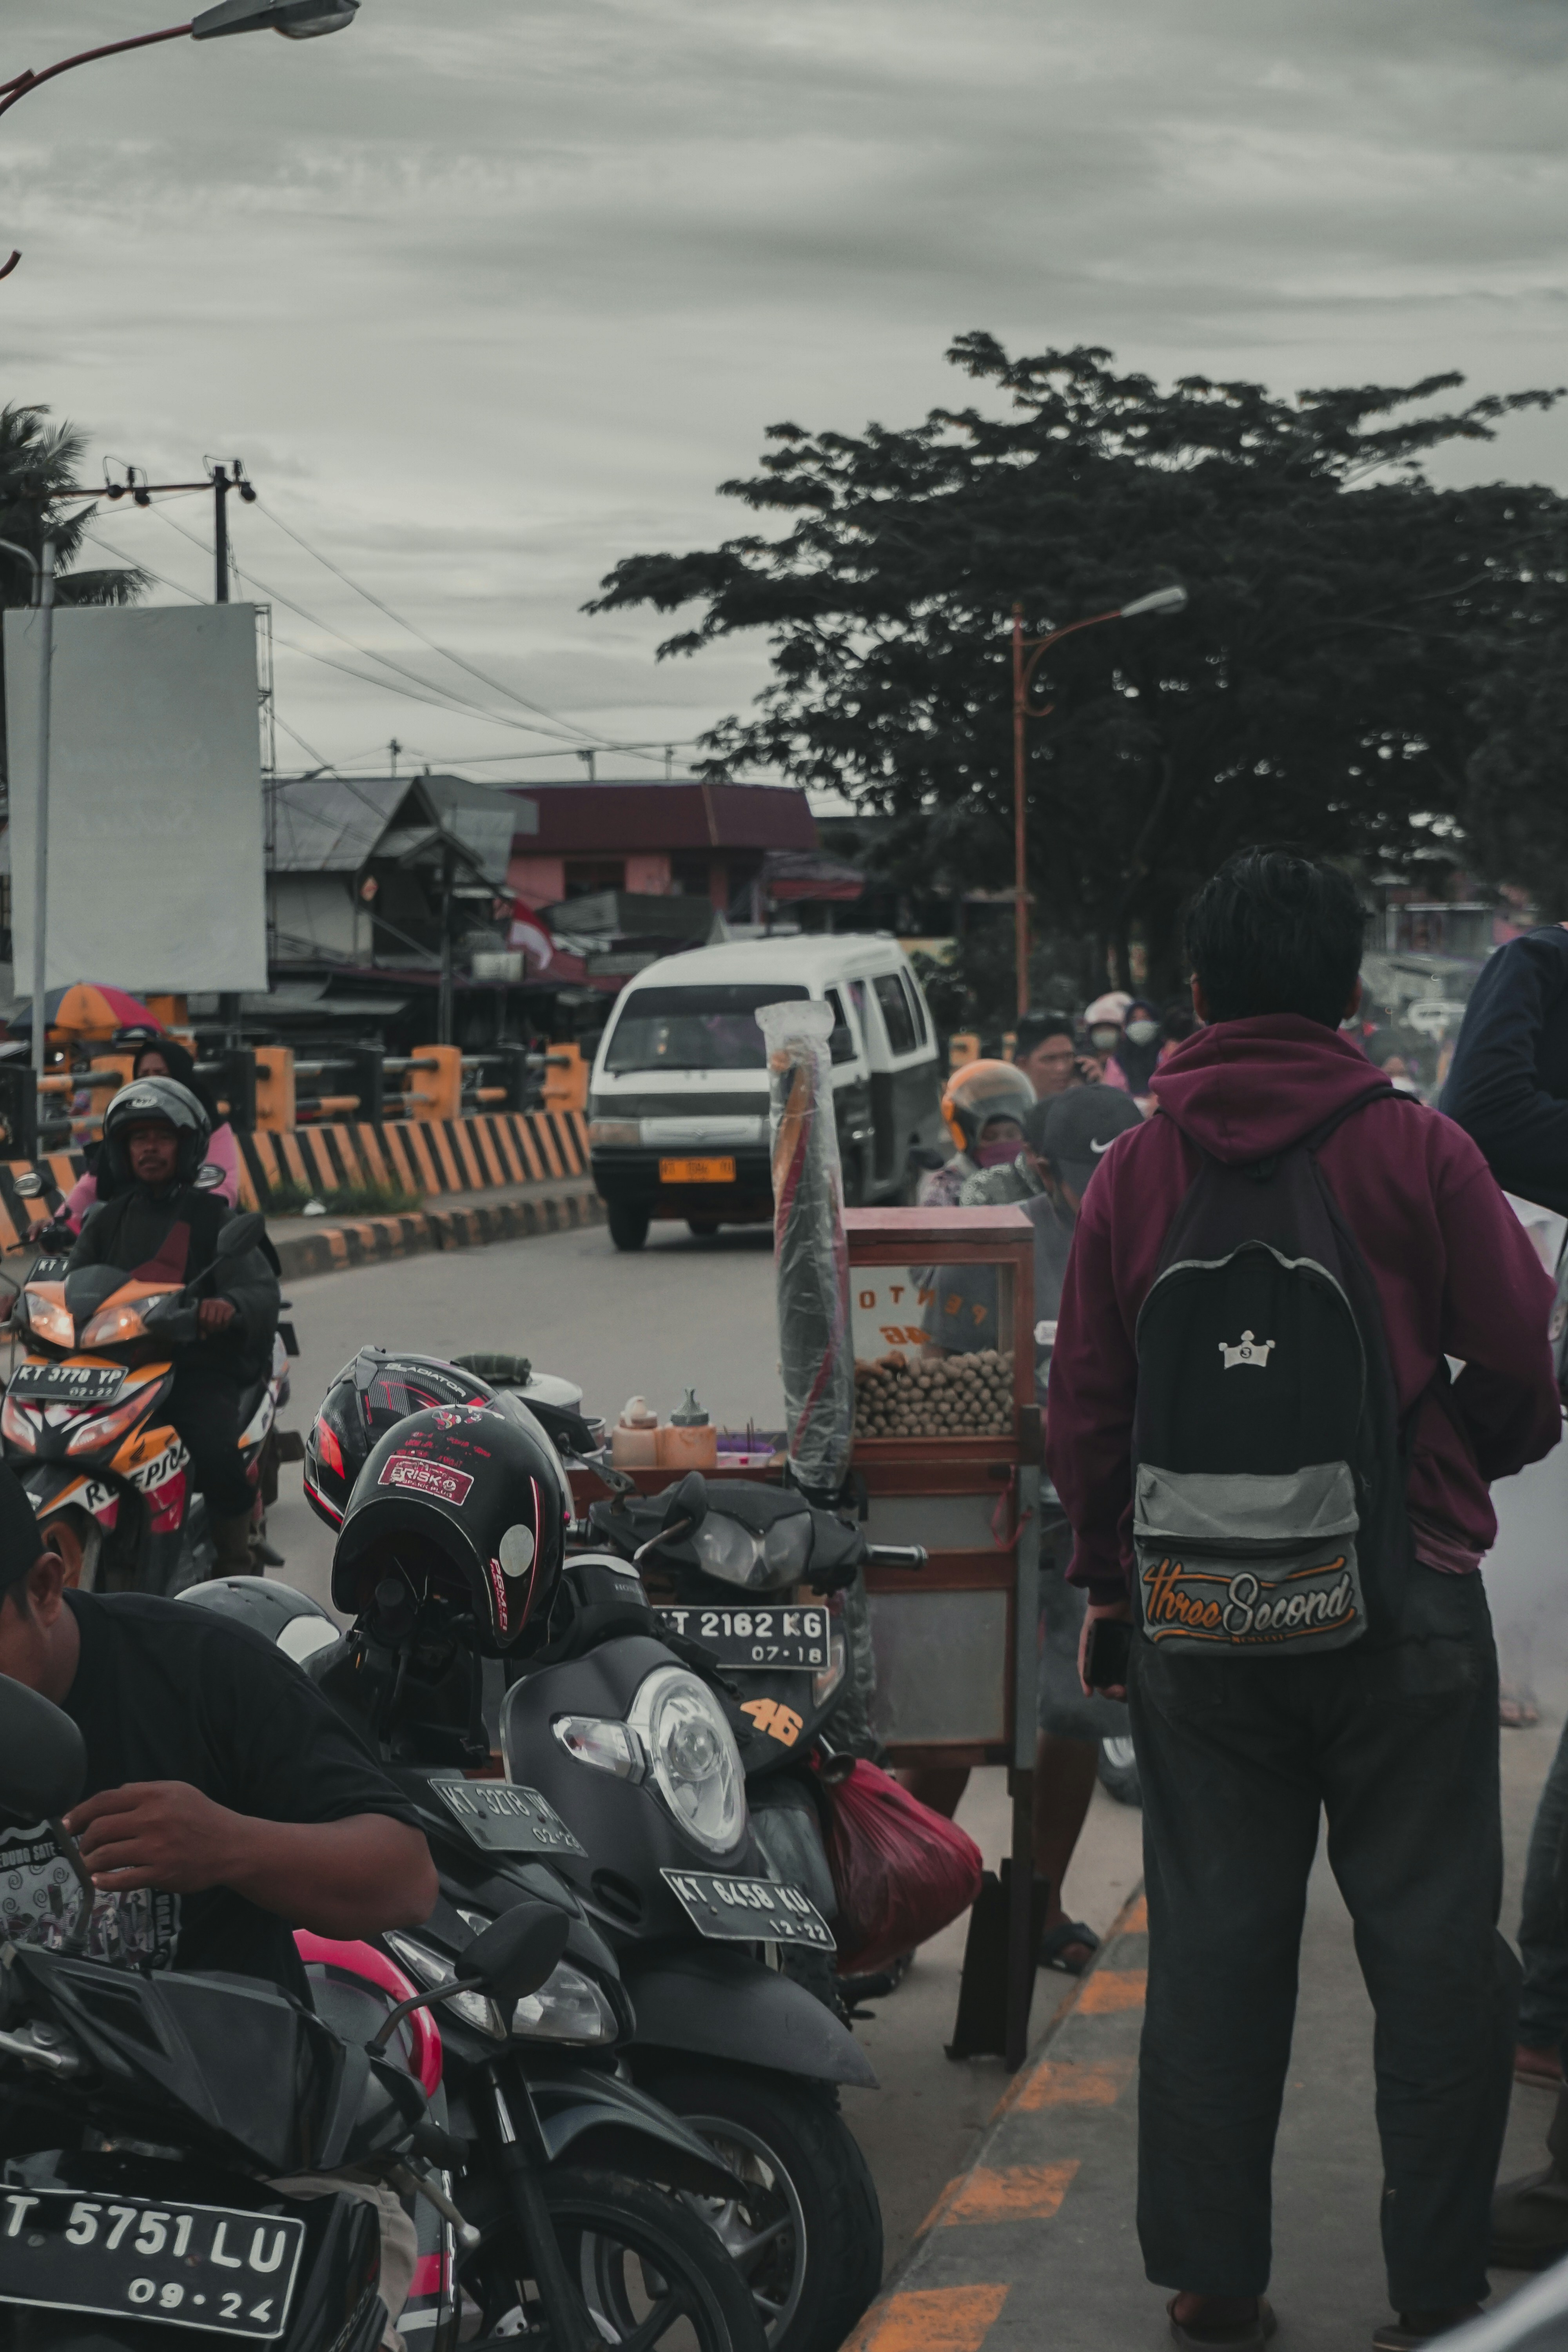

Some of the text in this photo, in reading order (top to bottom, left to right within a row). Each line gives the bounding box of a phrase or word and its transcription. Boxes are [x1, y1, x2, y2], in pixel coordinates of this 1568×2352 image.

[18, 1366, 47, 1381] KT
[98, 1370, 122, 1385] YP
[1223, 1572, 1354, 1635] Second
[701, 1612, 773, 1637] 2162
[784, 1612, 822, 1638] KG
[740, 1698, 803, 1747] 46
[441, 1786, 478, 1815] KT
[476, 1788, 530, 1817] 3278
[671, 1876, 810, 1914] KT 6458 KU
[66, 2202, 193, 2257] 5751
[210, 2221, 286, 2272] LU
